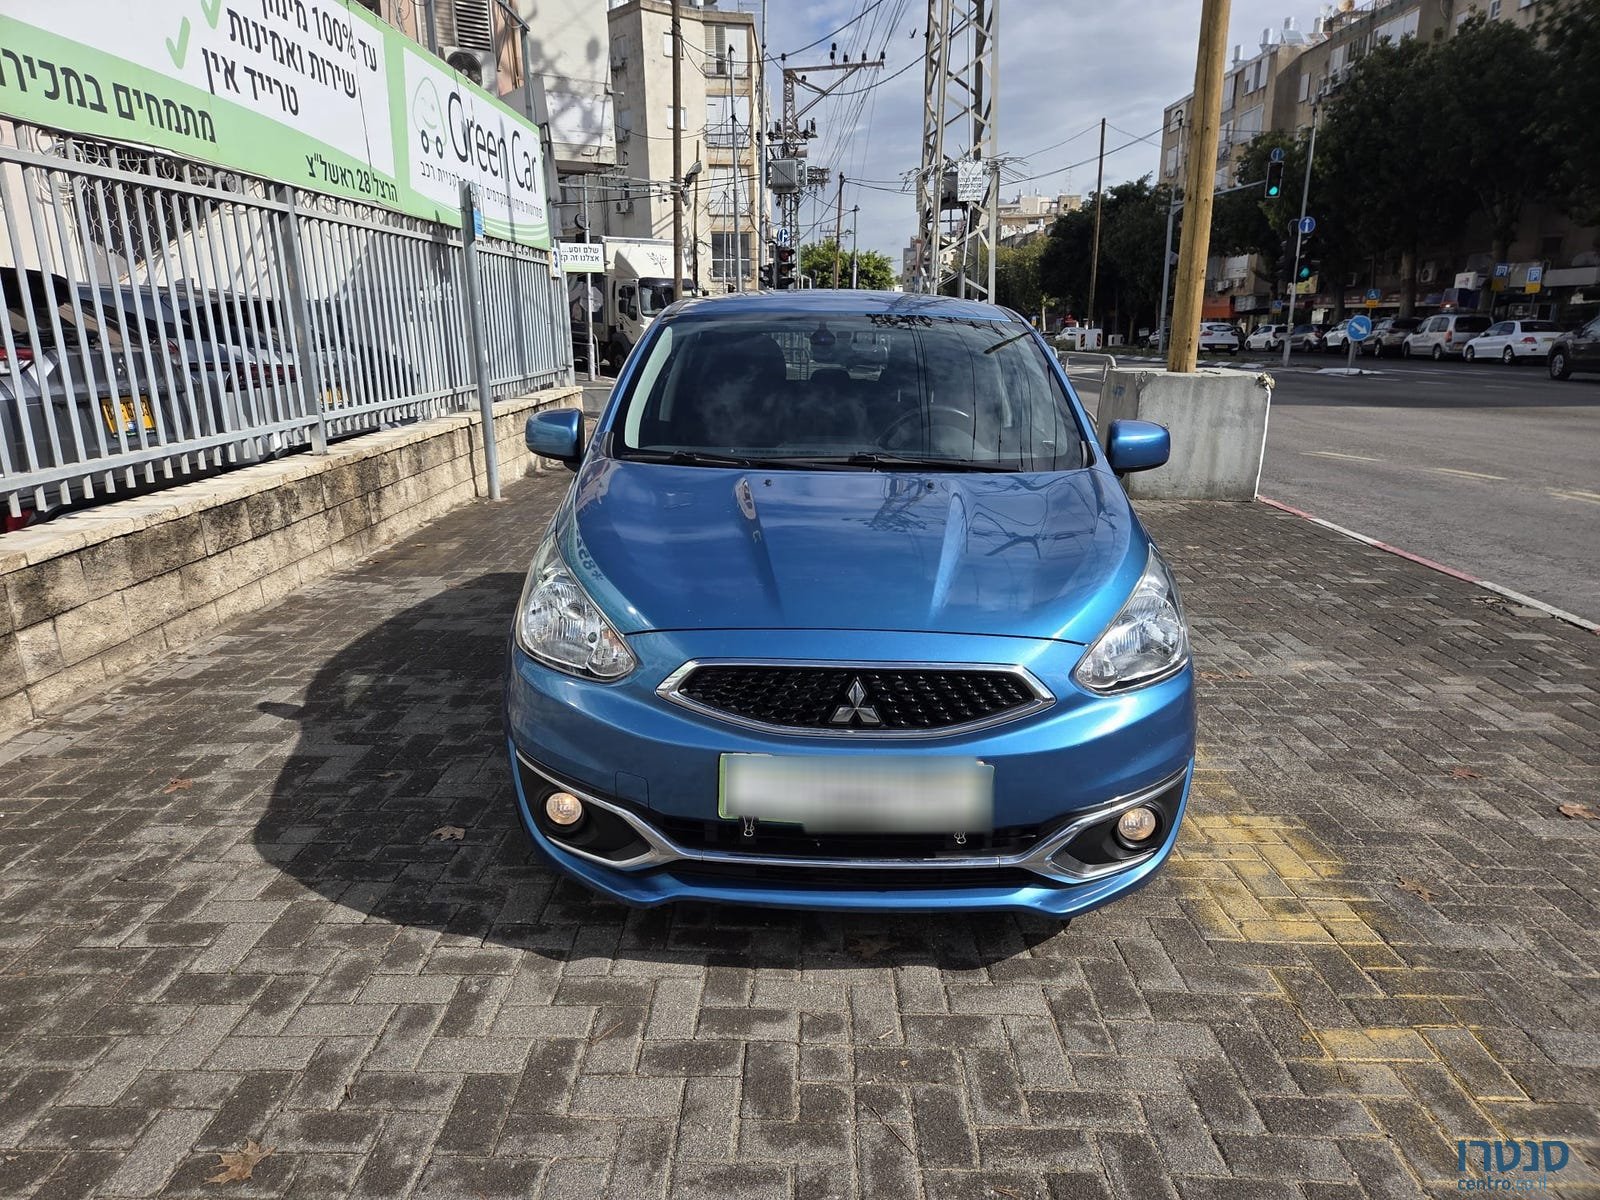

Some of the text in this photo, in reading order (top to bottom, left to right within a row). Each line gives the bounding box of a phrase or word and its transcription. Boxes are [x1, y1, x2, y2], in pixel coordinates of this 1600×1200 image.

[226, 7, 357, 99] שירות ואמינות
[311, 6, 357, 60] 100%
[358, 38, 378, 72] עד
[201, 47, 299, 116] טרייד אין
[112, 82, 217, 143] מתמחים
[448, 91, 537, 194] Green Car
[356, 168, 371, 194] 28
[372, 172, 398, 203] הרצל
[420, 161, 435, 179] רכב
[580, 254, 599, 262] אצלנו
